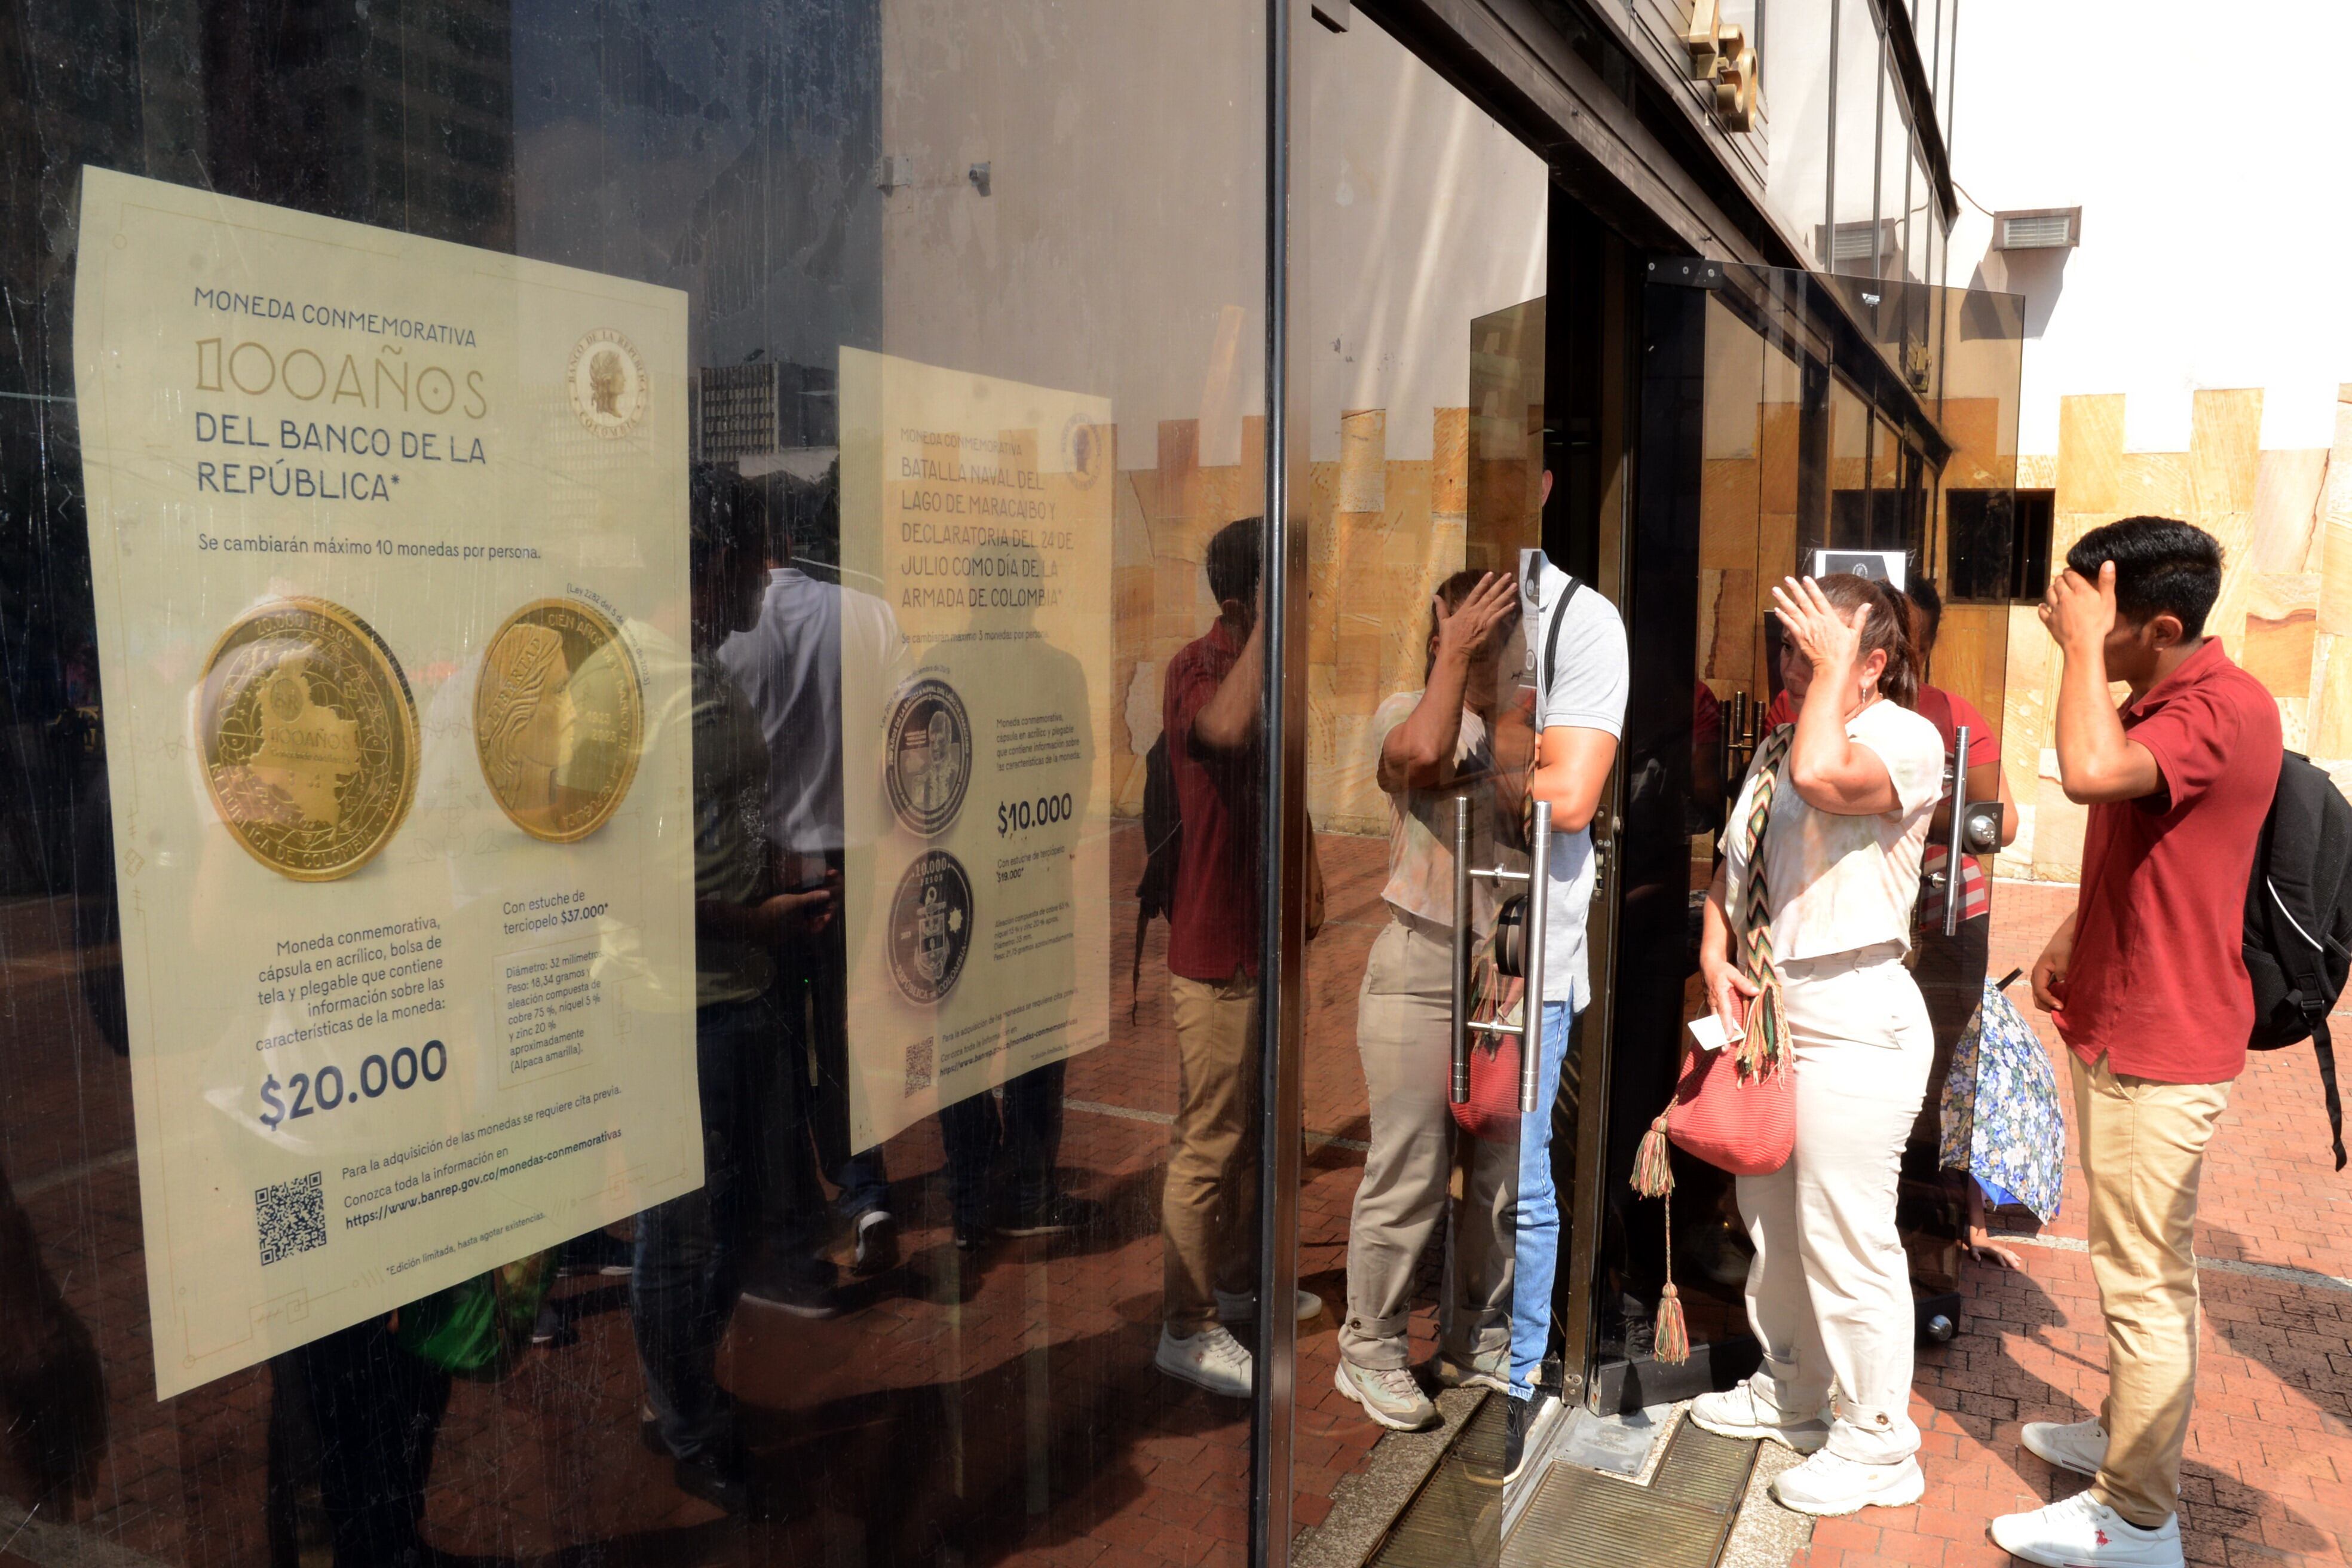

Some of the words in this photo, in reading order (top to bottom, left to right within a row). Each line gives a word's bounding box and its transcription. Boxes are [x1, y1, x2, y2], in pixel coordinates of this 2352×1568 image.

[194, 286, 296, 321] MONEDA
[302, 304, 476, 348] CONMEMORATIVA
[195, 411, 270, 448] DEL
[280, 419, 390, 457] BANCO
[401, 431, 442, 461] DE
[450, 436, 486, 465] LA
[901, 427, 942, 445] MONEDA
[944, 435, 1022, 457] CONMEMORATIVA
[901, 457, 967, 483] BATALLA
[971, 467, 1015, 488] NAVAL
[1018, 470, 1045, 491] DEL
[902, 490, 941, 512] LAGO
[947, 494, 966, 514] DE
[969, 497, 1046, 520] MARACAIBO
[1048, 503, 1056, 520] Y
[198, 532, 219, 551] Se
[223, 534, 309, 553] cambiarán
[313, 536, 372, 555] máximo
[376, 539, 393, 556] 10
[397, 541, 460, 558] monedas
[463, 546, 485, 561] por
[488, 547, 541, 561] persona.
[902, 523, 1009, 545] DECLARATORIA
[1012, 529, 1039, 549] DEL
[1042, 531, 1055, 549] 24
[1057, 532, 1074, 550] DE
[901, 556, 948, 576] JULIO
[952, 557, 993, 577] COMO
[997, 553, 1018, 577] DÍA
[1022, 559, 1039, 577] DE
[1043, 561, 1058, 578] LA
[902, 588, 965, 608] ARMADA
[969, 588, 987, 608] DE
[255, 612, 304, 635] 20.000
[310, 616, 354, 649] PESOS
[548, 614, 574, 629] CIEN
[997, 792, 1073, 838] $10.000
[302, 831, 374, 868] COLOMBIA
[503, 901, 525, 915] Con
[528, 893, 570, 911] estuche
[572, 889, 586, 903] de
[276, 933, 335, 957] Moneda
[337, 916, 440, 945] conmemorativa,
[503, 914, 558, 935] terciopelo
[258, 960, 313, 983] cápsula
[315, 958, 332, 972] en
[336, 948, 387, 967] acrílico,
[390, 941, 424, 957] bolsa
[426, 936, 442, 950] de
[506, 963, 548, 979] Diámetro:
[550, 957, 560, 969] 32
[258, 988, 286, 1006] tela
[288, 988, 296, 1003] y
[300, 973, 358, 1000] plegable
[362, 970, 386, 986] que
[389, 958, 443, 978] contiene
[308, 989, 387, 1017] información
[391, 983, 425, 999] sobre
[428, 978, 445, 991] las
[507, 982, 529, 994] Peso:
[531, 975, 554, 988] 18,34
[555, 969, 586, 985] gramos
[507, 994, 544, 1010] aleación
[546, 983, 589, 1001] compuesta
[591, 980, 601, 989] de
[255, 1019, 354, 1052] características
[357, 1013, 373, 1028] de
[376, 1010, 389, 1023] la
[391, 998, 446, 1020] moneda:
[508, 1033, 514, 1043] y
[516, 1027, 533, 1039] zinc
[535, 1022, 546, 1034] 20
[547, 1020, 556, 1031] %
[510, 1029, 585, 1056] aproximadamente
[510, 1056, 544, 1074] (Alpaca
[545, 1043, 583, 1062] amarilla).
[259, 1040, 447, 1131] $20.000
[342, 1165, 368, 1180] Para
[369, 1159, 381, 1171] la
[383, 1140, 443, 1168] adquisición
[445, 1135, 459, 1148] de
[461, 1131, 475, 1143] las
[477, 1117, 522, 1138] monedas
[523, 1113, 534, 1124] se
[535, 1101, 573, 1119] requiere
[575, 1095, 592, 1107] cita
[593, 1086, 621, 1104] previa.
[344, 1186, 393, 1208] Conozca
[394, 1175, 419, 1192] toda
[421, 1171, 431, 1183] la
[433, 1151, 494, 1179] información
[496, 1147, 509, 1159] en
[345, 1128, 622, 1230] https://www.banrep.gov.co/monedas-conmemorativas
[422, 1245, 456, 1263] limitada,
[457, 1236, 478, 1250] hasta
[479, 1227, 504, 1242] agotar
[504, 1212, 546, 1232] existencias.
